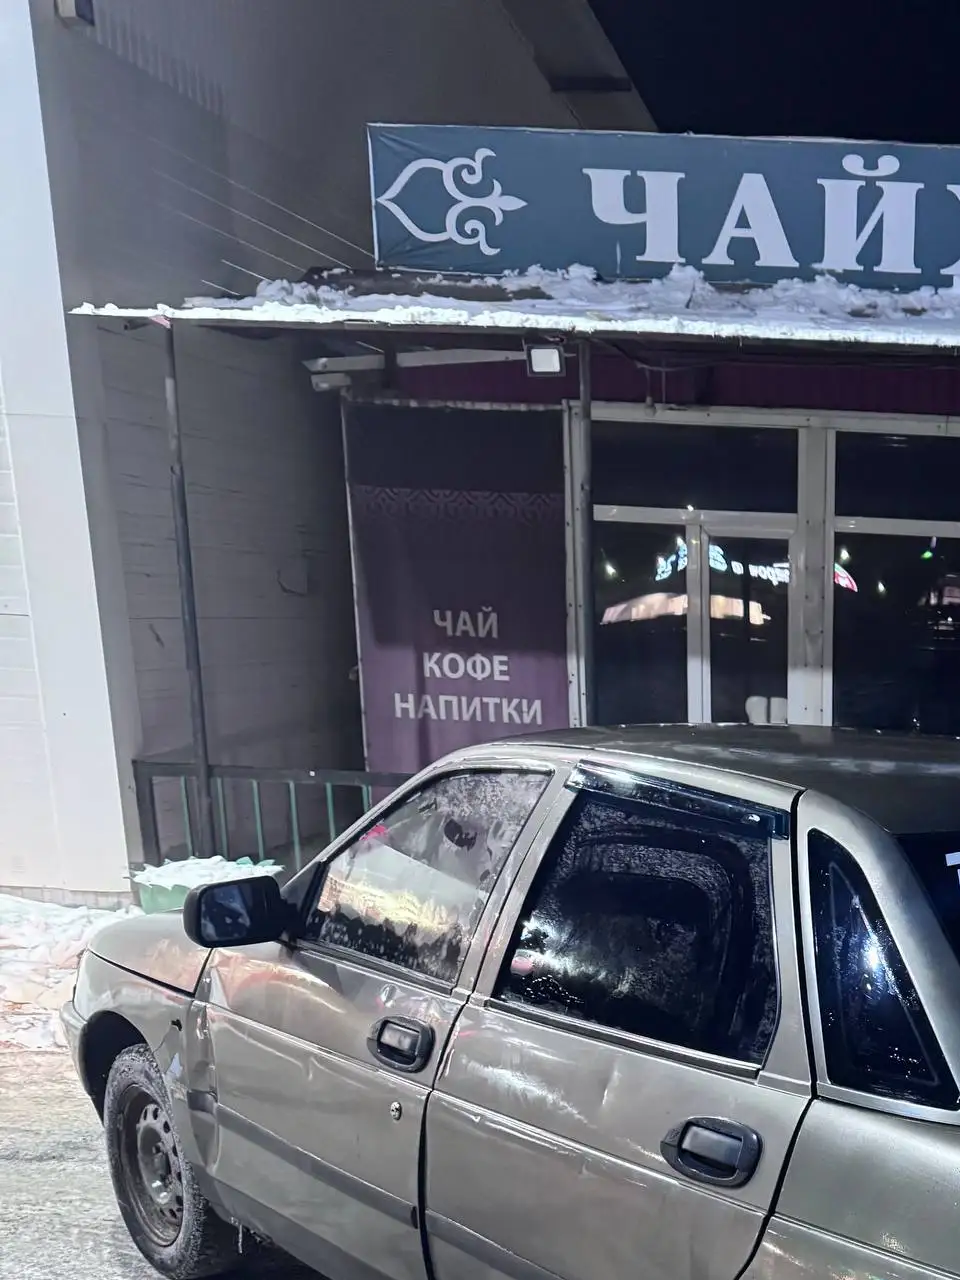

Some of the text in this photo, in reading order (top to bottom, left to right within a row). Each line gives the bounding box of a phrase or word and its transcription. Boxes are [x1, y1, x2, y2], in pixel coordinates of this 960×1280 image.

[432, 606, 499, 639] ЧАЙ
[422, 651, 511, 681] КОФЕ
[393, 693, 543, 725] НАПИТКИ
